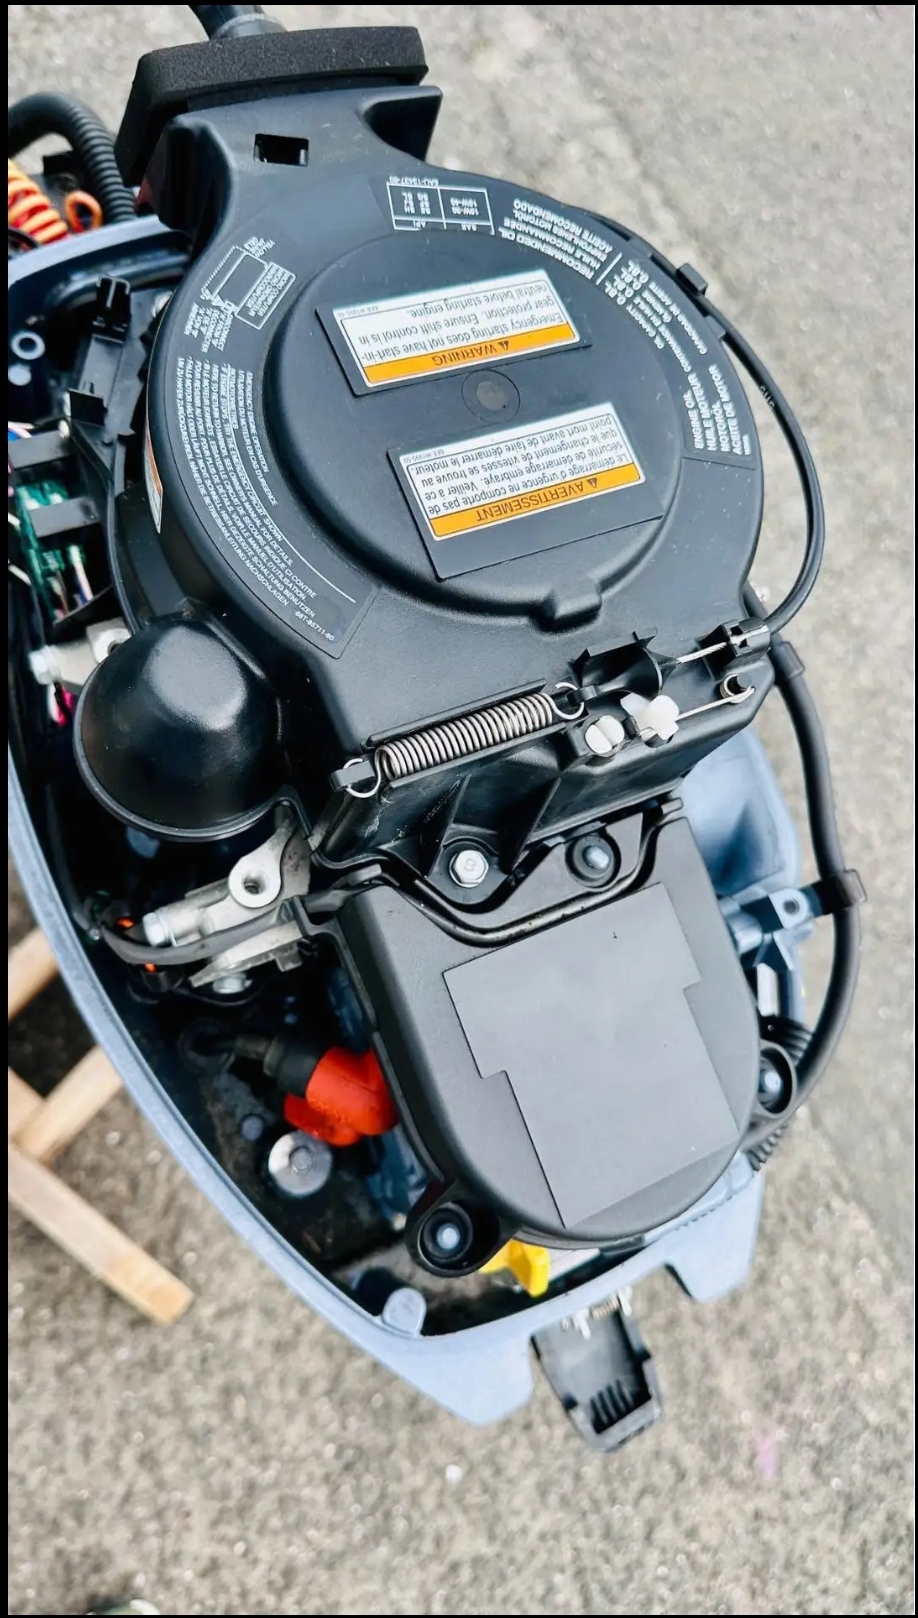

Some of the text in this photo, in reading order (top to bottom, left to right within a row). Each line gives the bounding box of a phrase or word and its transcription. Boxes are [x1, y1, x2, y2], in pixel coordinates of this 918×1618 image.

[511, 196, 614, 255] ACEITE RECOMENDADO
[495, 225, 596, 280] RECOMMENDED OIL
[573, 247, 602, 270] HUILE
[405, 281, 547, 321] neutral before starting engine.
[647, 279, 674, 307] ACEITE
[667, 301, 682, 317] DE
[357, 294, 555, 347] gear protection. Ensure shift control is in
[360, 307, 563, 363] Emergency starting does not have start-in-
[624, 302, 657, 338] CAPACITY
[430, 341, 497, 367] WARNING
[651, 333, 667, 350] OIL
[238, 406, 246, 417] DU
[680, 388, 704, 449] ENGINE OIL
[685, 371, 718, 452] HUILE MOTEUR
[706, 362, 743, 456] ACEITE DE MOTOR
[708, 399, 731, 453] MOTORÖL
[199, 436, 211, 458] POUR
[239, 416, 252, 445] MOTEUR
[410, 414, 612, 477] point mort avant de faire démarrer le moteur.
[204, 455, 216, 475] PLUS
[245, 444, 254, 456] EN
[249, 454, 260, 470] CAS
[251, 434, 269, 473] OPERATION
[420, 425, 617, 488] que le changement de vitesses se trouve au
[211, 473, 221, 486] DE
[219, 470, 228, 481] LE
[423, 439, 623, 502] sécurité de démarrage embrayé. Veiller à ce
[427, 452, 629, 516] Le démarrage d'urgence ne comporte pas de
[223, 456, 234, 473] SEE
[242, 499, 264, 529] MANUAL
[259, 526, 273, 542] FOR
[269, 539, 295, 567] DETAILS.
[236, 504, 247, 517] DE
[246, 489, 265, 518] CIRCUIT
[262, 516, 283, 542] SHOWN
[474, 480, 585, 521] AVERTISSEMENT
[230, 512, 245, 530] VOIR
[240, 527, 251, 539] LE
[241, 513, 267, 547] SECOURS
[219, 509, 233, 528] HIER
[229, 524, 255, 559] GEZEIGTE
[250, 554, 285, 592] SCHALTUNG
[281, 588, 316, 619] BENUTZEN
[246, 535, 270, 564] MANUEL
[262, 543, 288, 571] INDIQUE
[243, 558, 289, 607] NACHSCHLAGEN
[283, 567, 293, 577] CI
[289, 573, 317, 599] CONTRE
